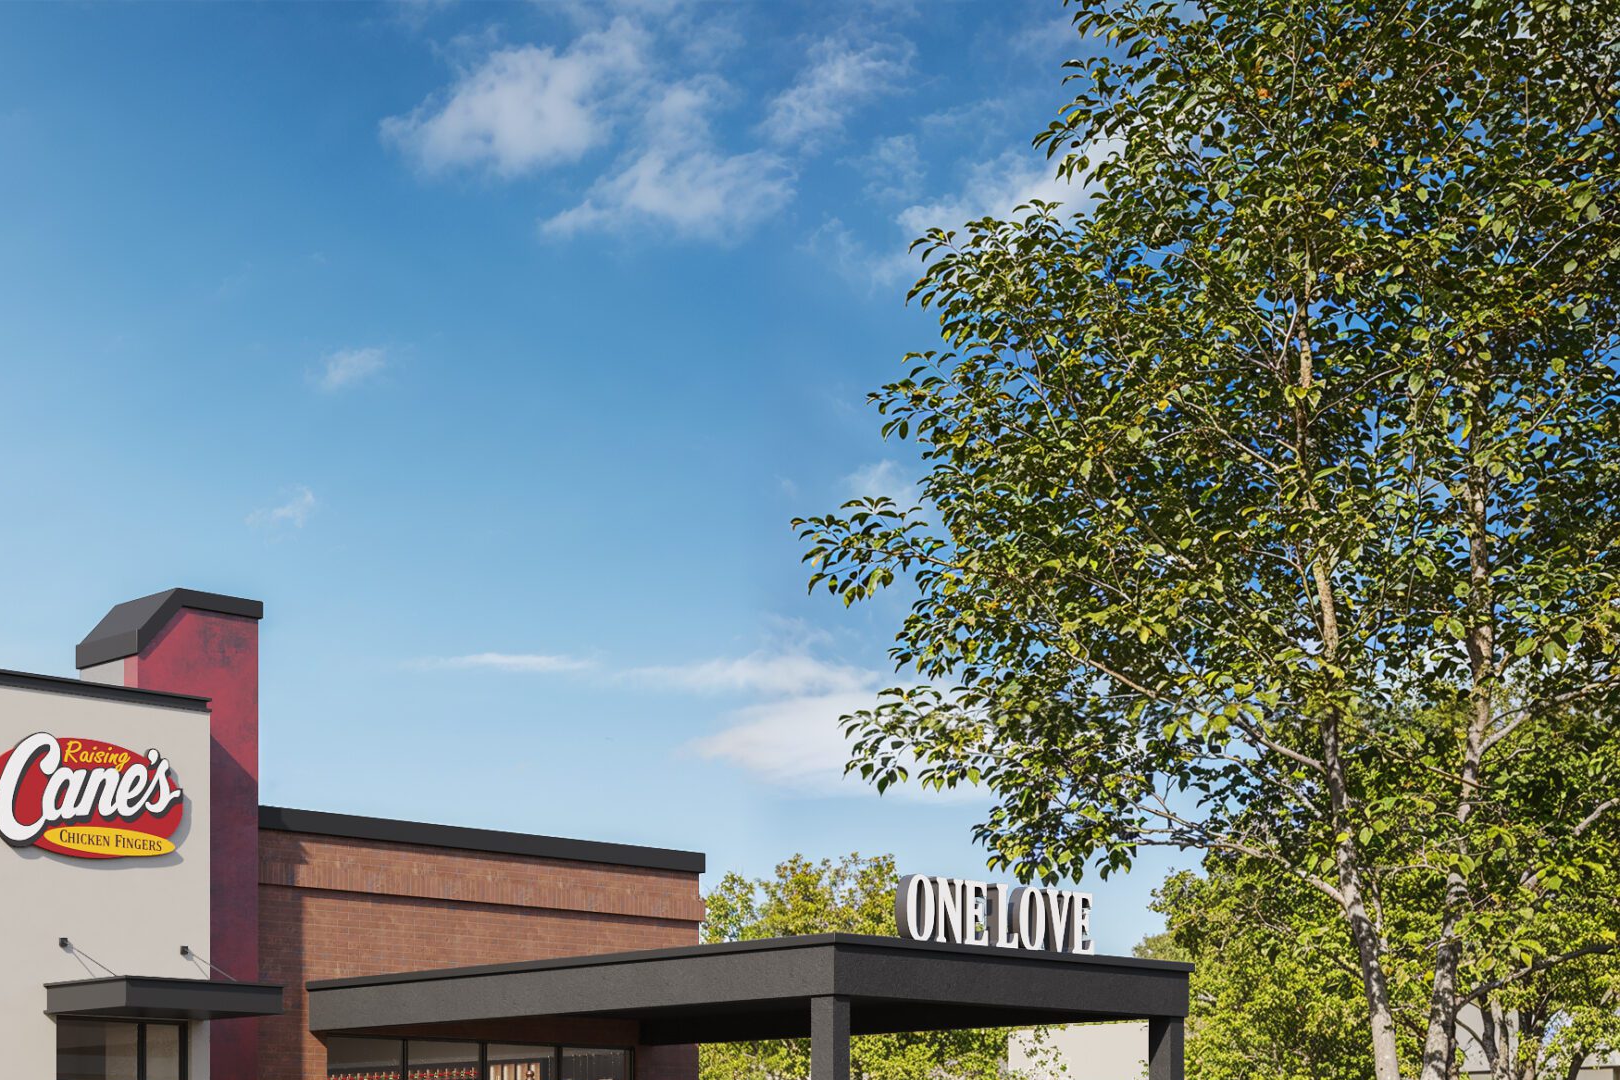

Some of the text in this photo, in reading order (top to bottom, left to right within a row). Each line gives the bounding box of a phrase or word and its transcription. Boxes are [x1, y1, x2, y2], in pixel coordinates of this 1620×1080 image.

[63, 739, 131, 772] Raising
[59, 828, 163, 852] CHICKEN FINGERS
[905, 873, 1095, 956] ONE LOVE
